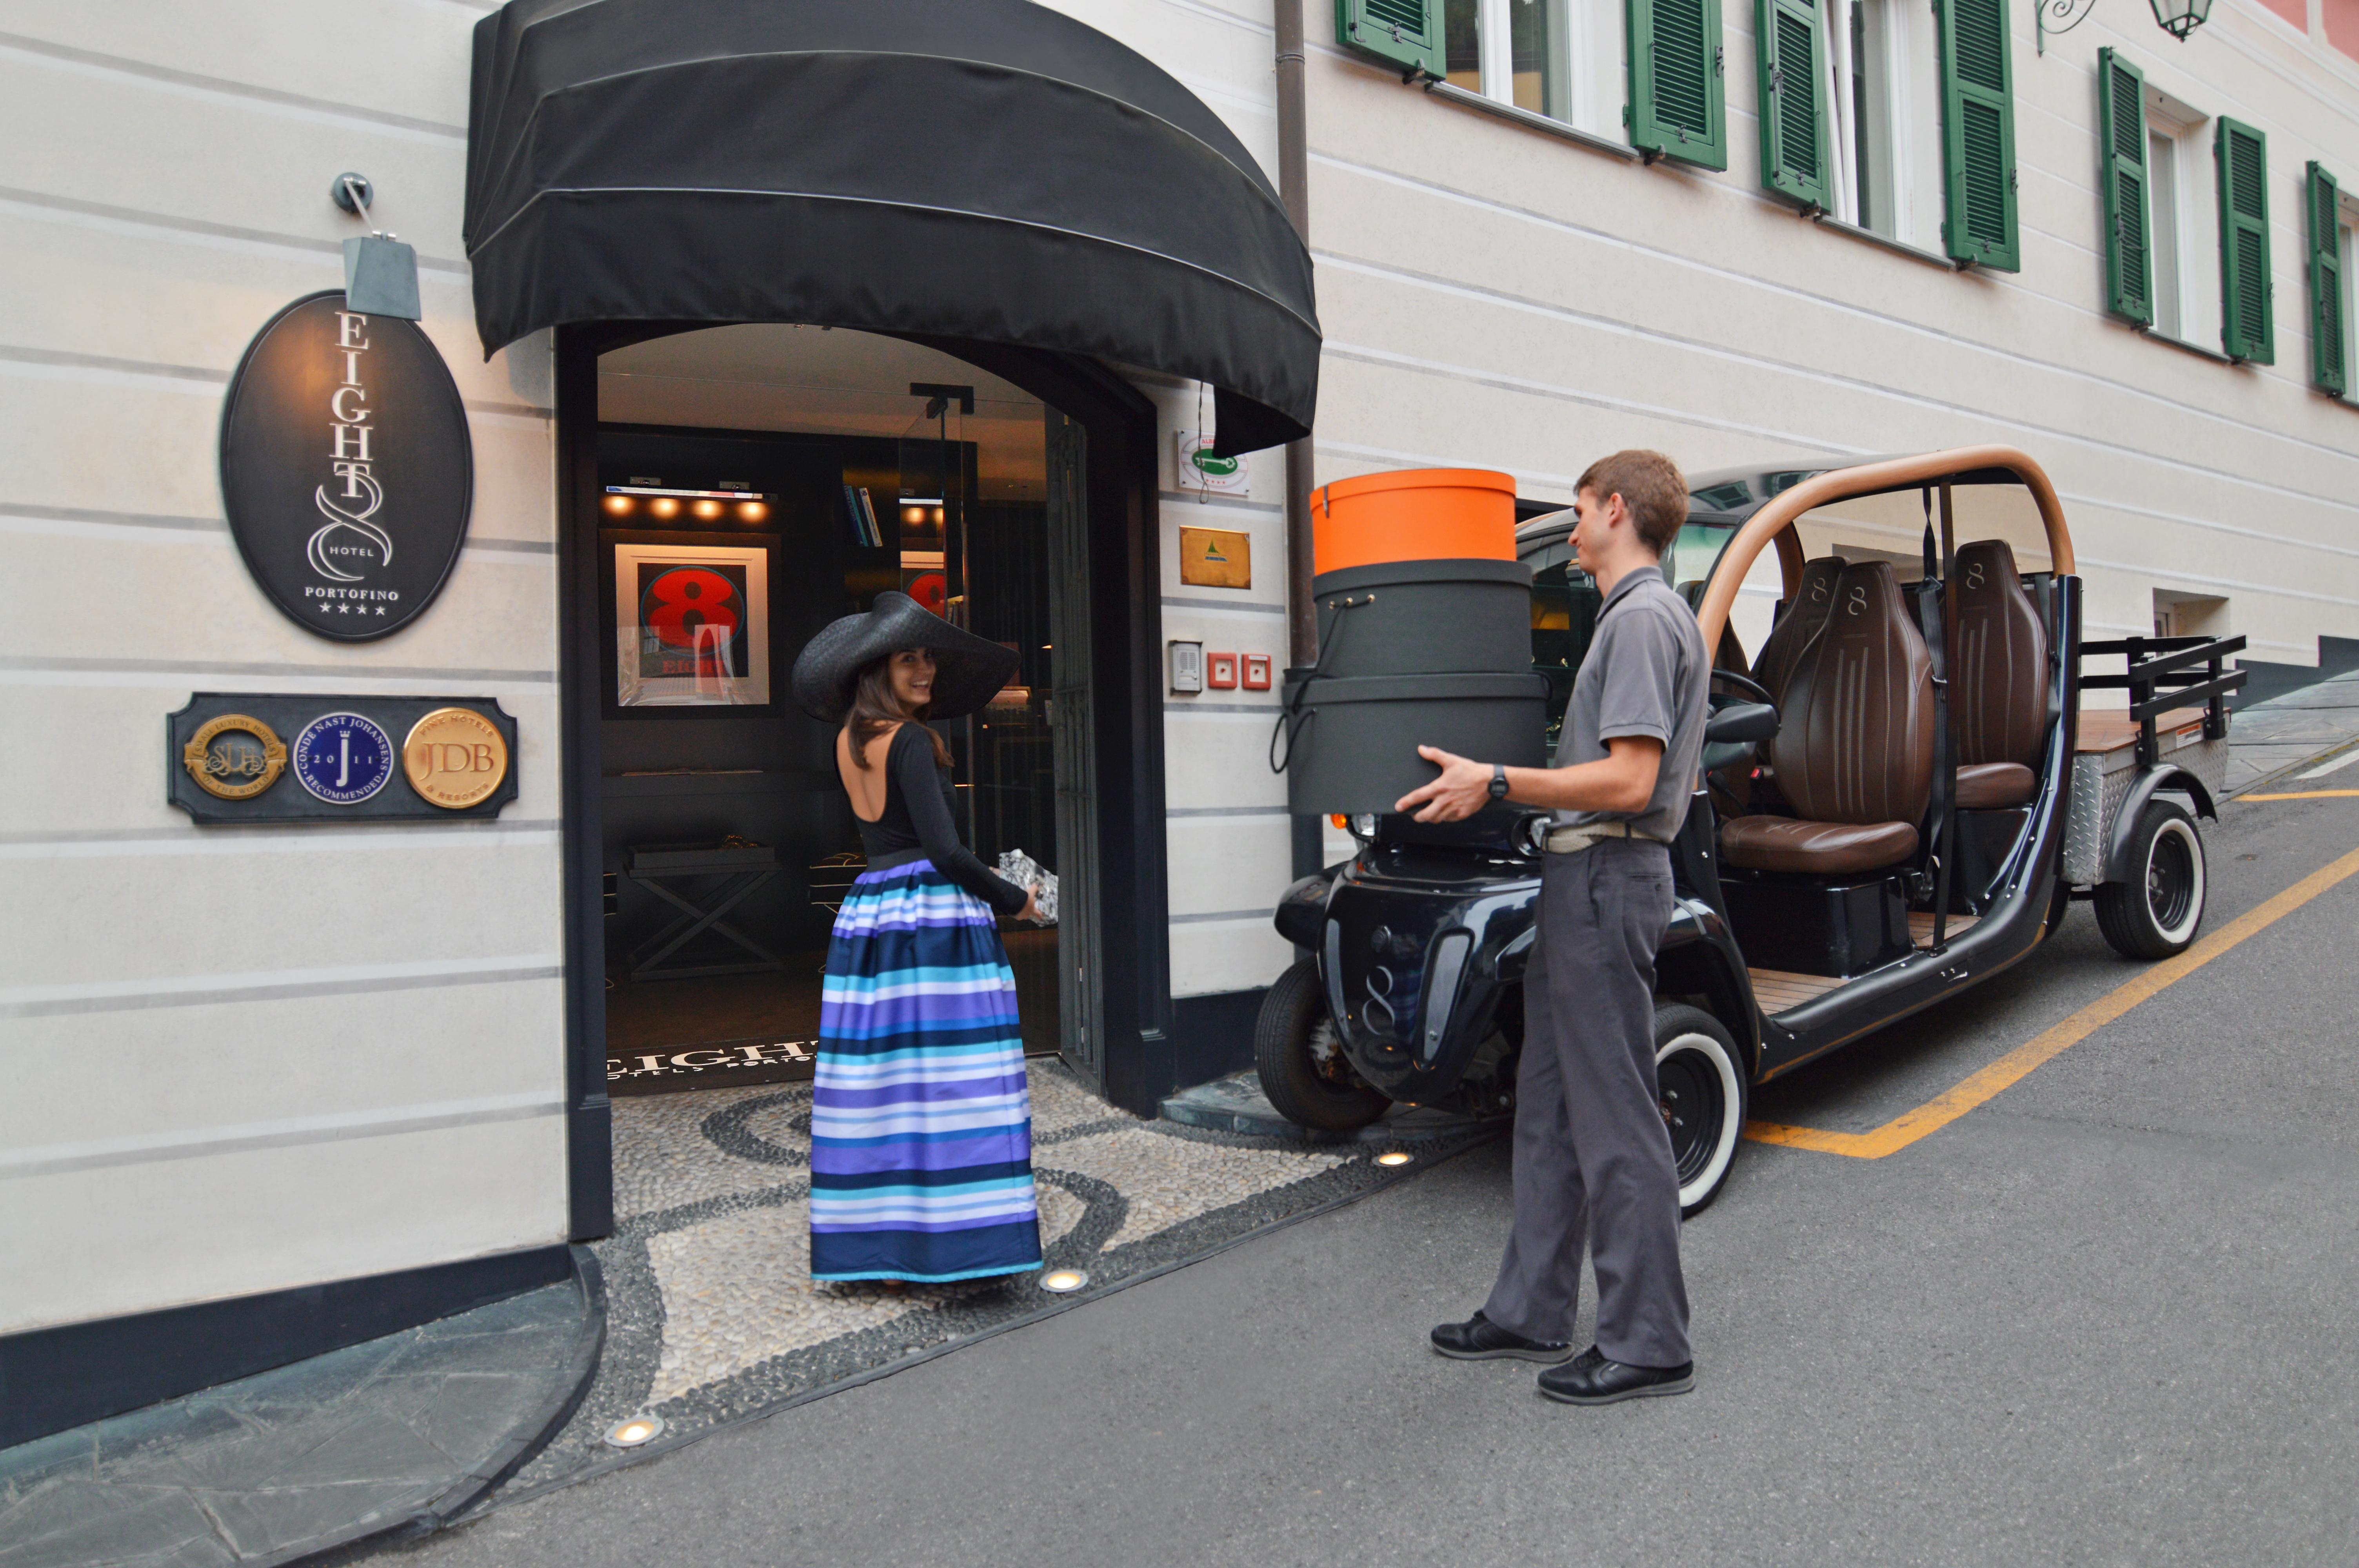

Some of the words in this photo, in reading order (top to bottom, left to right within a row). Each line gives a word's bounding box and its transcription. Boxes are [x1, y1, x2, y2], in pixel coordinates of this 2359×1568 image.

[329, 312, 373, 497] EIGHT
[329, 546, 374, 557] HOTEL
[1812, 577, 1827, 601] 8
[1966, 563, 1984, 589] 8
[305, 587, 399, 601] PORTOFINO
[1848, 587, 1866, 615] 8
[650, 570, 738, 648] 8
[196, 728, 213, 753] SMALL
[215, 719, 251, 729] LUXURY
[253, 726, 276, 752] HOTELS
[419, 717, 445, 736] FINE
[450, 715, 494, 737] HOTELS
[315, 717, 346, 732] NAST
[350, 718, 389, 771] JOHANSENS
[420, 742, 494, 781] JDB
[216, 784, 234, 795] THE
[238, 776, 269, 794] WORLD
[305, 775, 382, 800] RECOMMENDED
[437, 782, 489, 801] RESORTS
[1361, 965, 1396, 1035] 8
[607, 1040, 818, 1074] EIGH
[726, 1055, 817, 1068] PORTO
